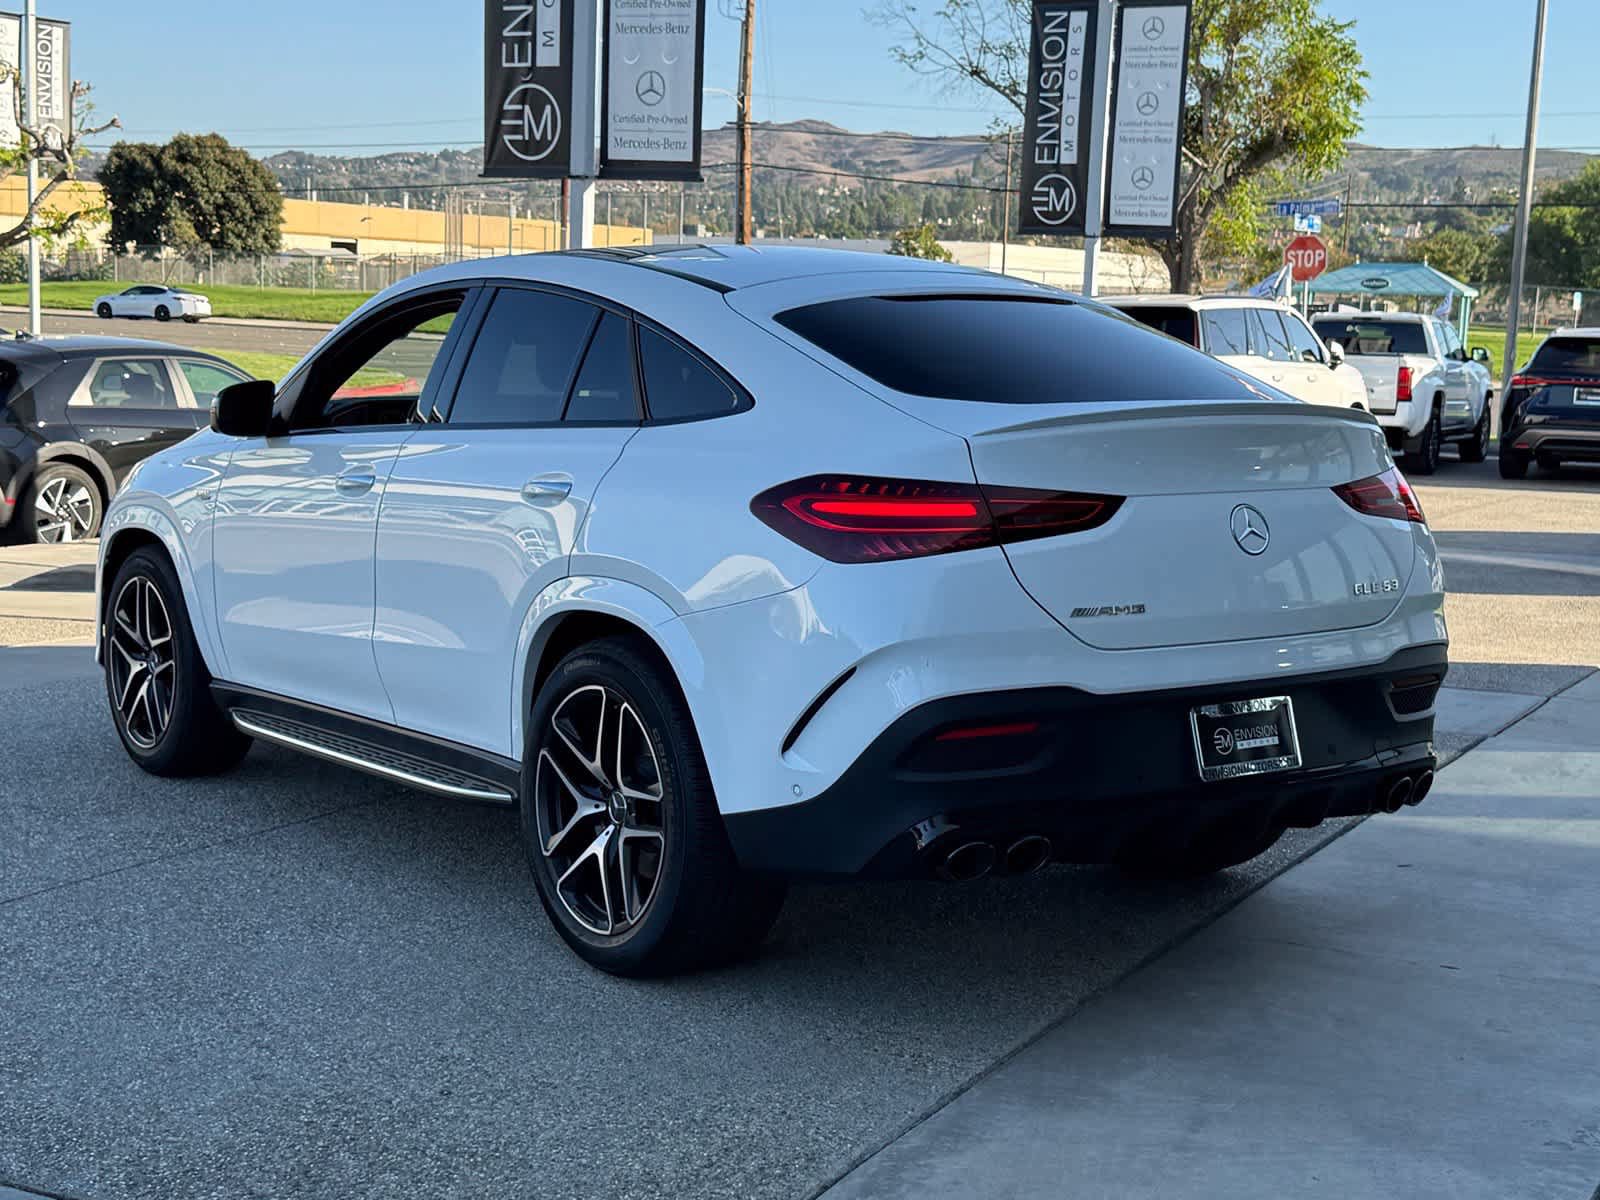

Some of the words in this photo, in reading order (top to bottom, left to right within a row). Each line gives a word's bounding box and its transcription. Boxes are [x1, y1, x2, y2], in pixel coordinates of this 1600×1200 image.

[615, 22, 690, 34] Mercedes-Benz
[37, 24, 53, 118] ENVISION
[1034, 11, 1069, 164] ENVISION
[1063, 24, 1083, 152] MOTORS
[614, 136, 688, 150] Mercedes-Benz
[1287, 249, 1325, 268] STOP
[1354, 582, 1379, 595] GLE
[1234, 724, 1279, 741] ENVISION
